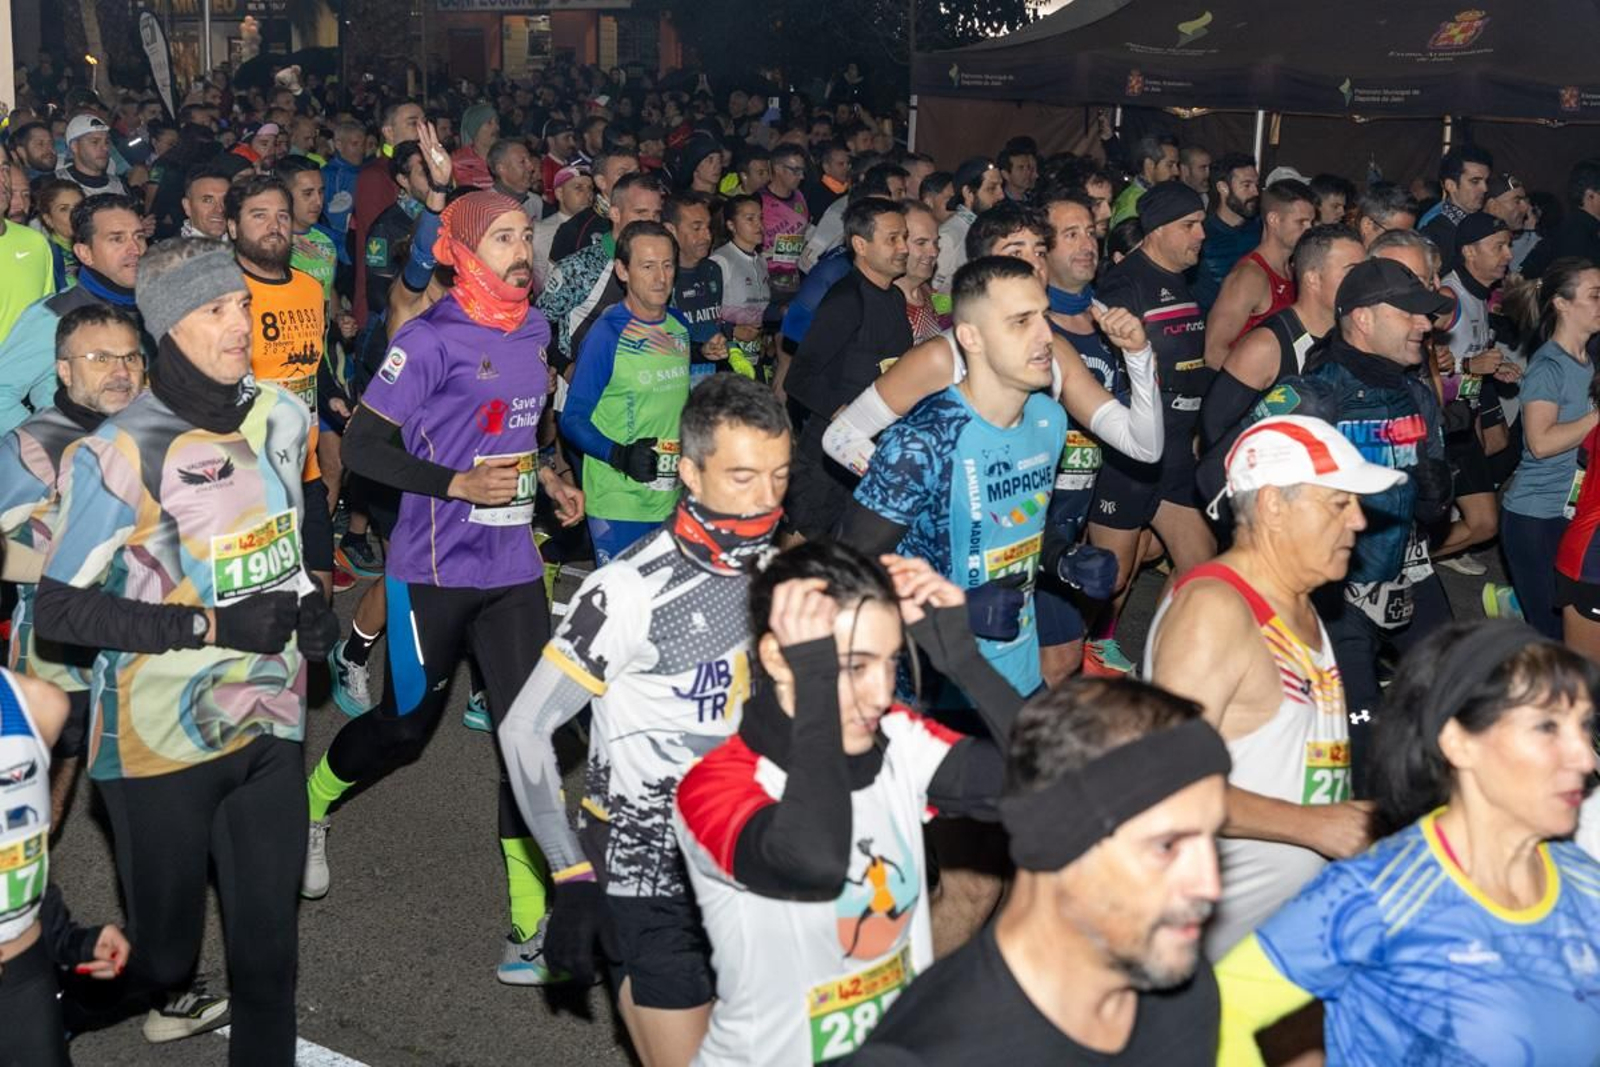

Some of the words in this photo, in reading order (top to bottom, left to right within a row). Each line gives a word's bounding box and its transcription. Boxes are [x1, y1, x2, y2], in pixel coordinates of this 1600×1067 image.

[261, 311, 280, 342] 8
[280, 309, 317, 325] CROSS
[511, 397, 536, 411] Save
[986, 465, 1052, 503] MAPACHE
[223, 536, 296, 589] 1909
[1309, 769, 1351, 805] 27
